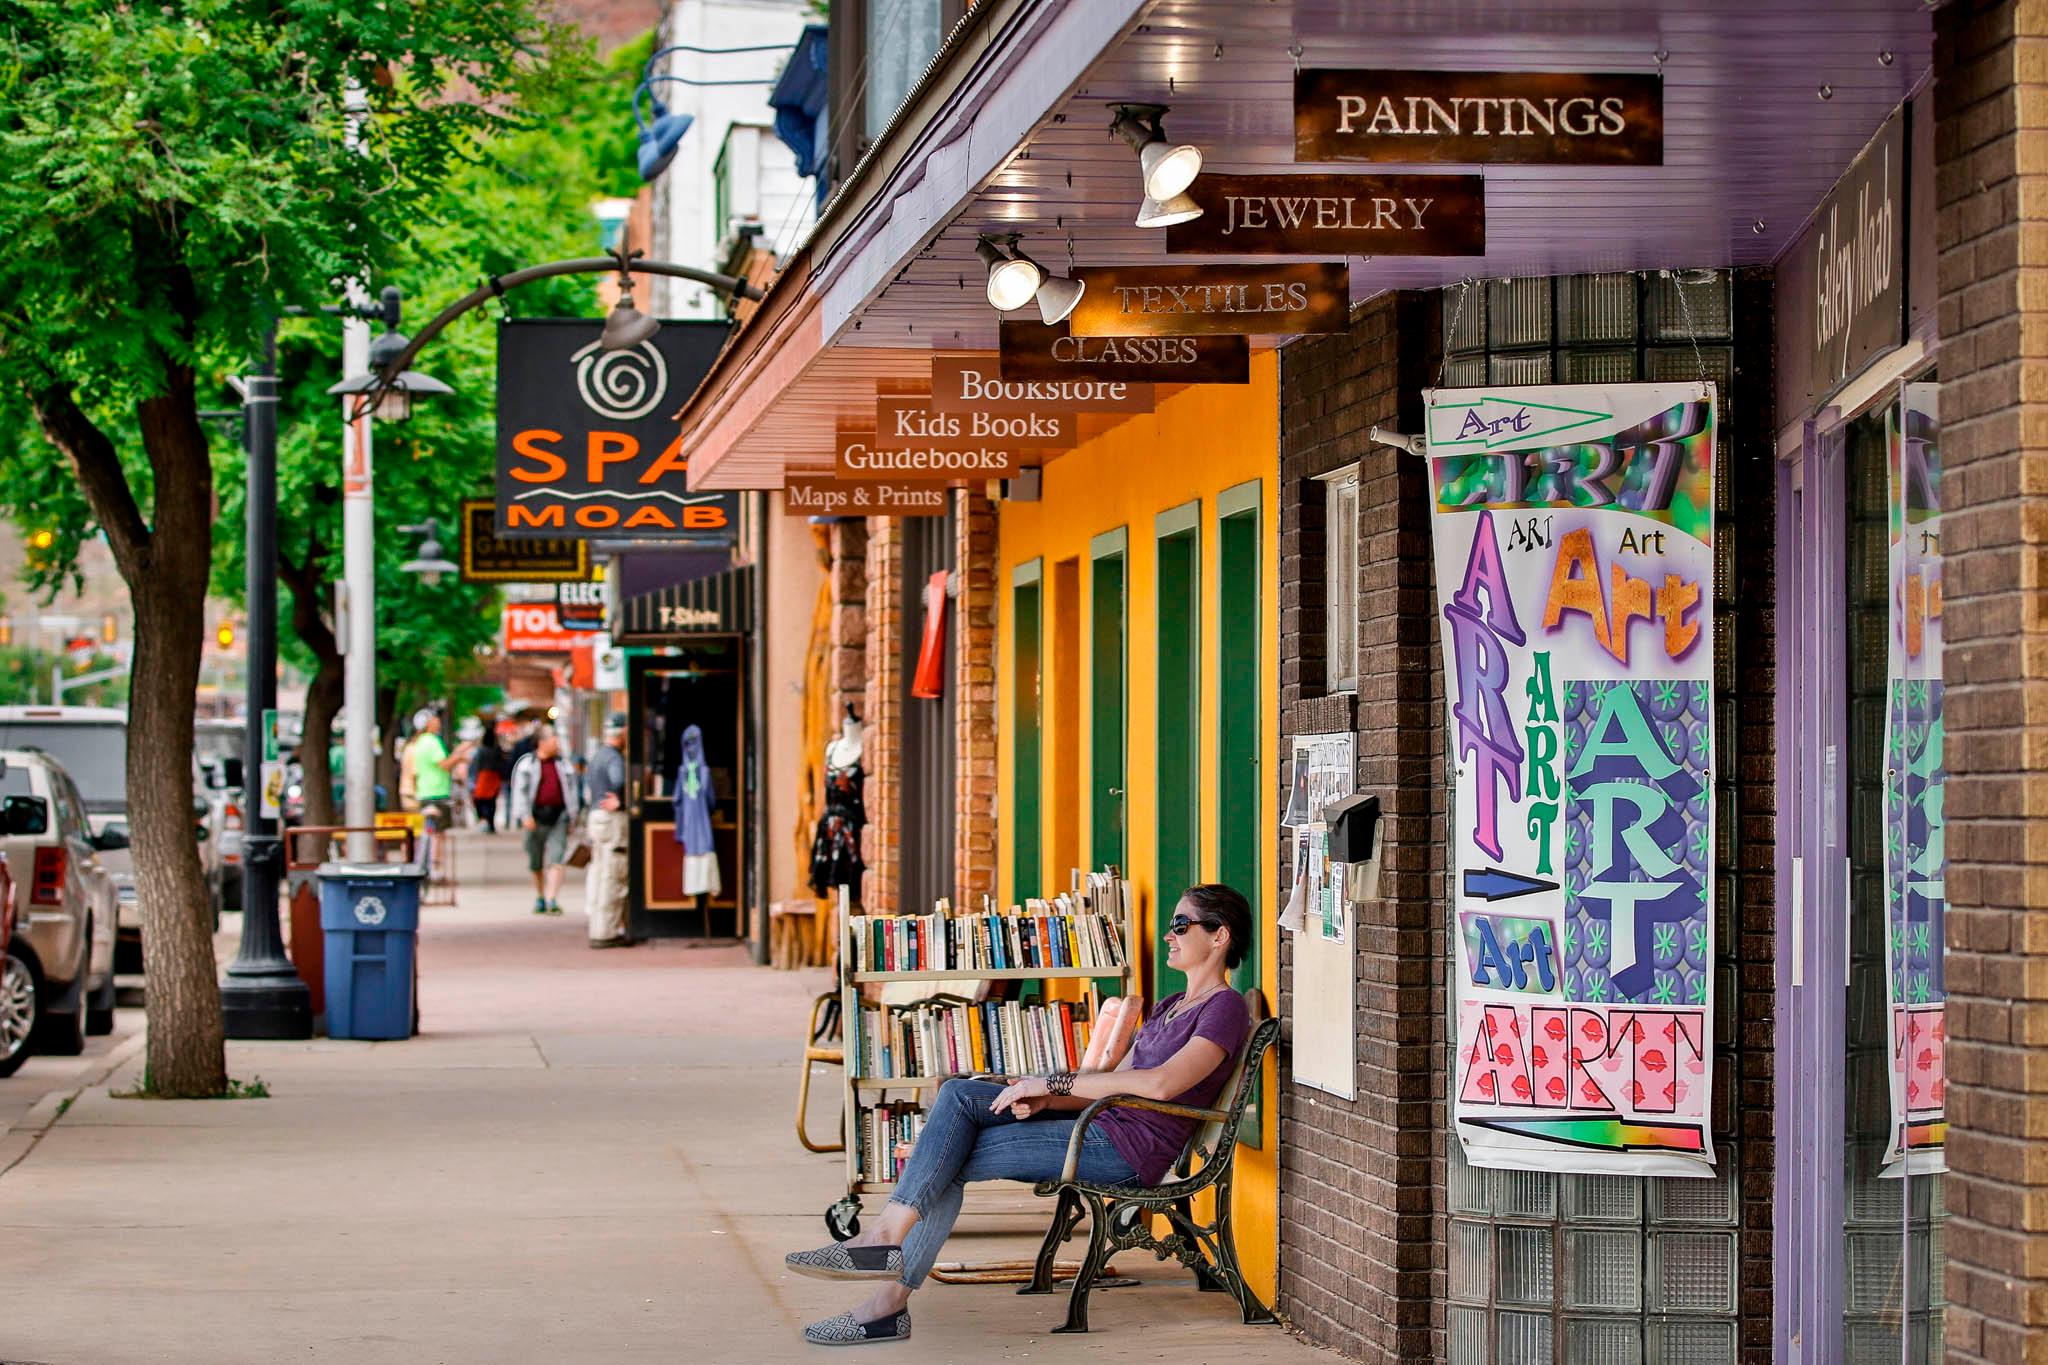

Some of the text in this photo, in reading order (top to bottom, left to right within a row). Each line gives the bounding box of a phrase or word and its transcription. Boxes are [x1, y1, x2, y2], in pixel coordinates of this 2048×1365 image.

[1335, 95, 1626, 137] PAINTINGS
[1221, 196, 1435, 236] JEWELRY
[1817, 143, 1892, 378] Gallery Moab
[1113, 282, 1309, 315] TEXTILES
[1051, 336, 1198, 364] CLASSES
[959, 370, 1127, 402] Bookstore
[895, 409, 1060, 437] Kids Books
[1455, 407, 1534, 440] Art
[844, 444, 1009, 470] Guidebooks
[789, 485, 943, 511] Maps & Prints
[507, 505, 728, 528] MOAB
[1507, 516, 1553, 551] ART
[1619, 527, 1665, 555] Art
[1542, 527, 1699, 663] Art
[1444, 510, 1526, 863] ART
[1525, 651, 1560, 876] ART
[1569, 682, 1696, 990] ART
[1472, 916, 1555, 992] Art
[1459, 1004, 1704, 1113] ART
